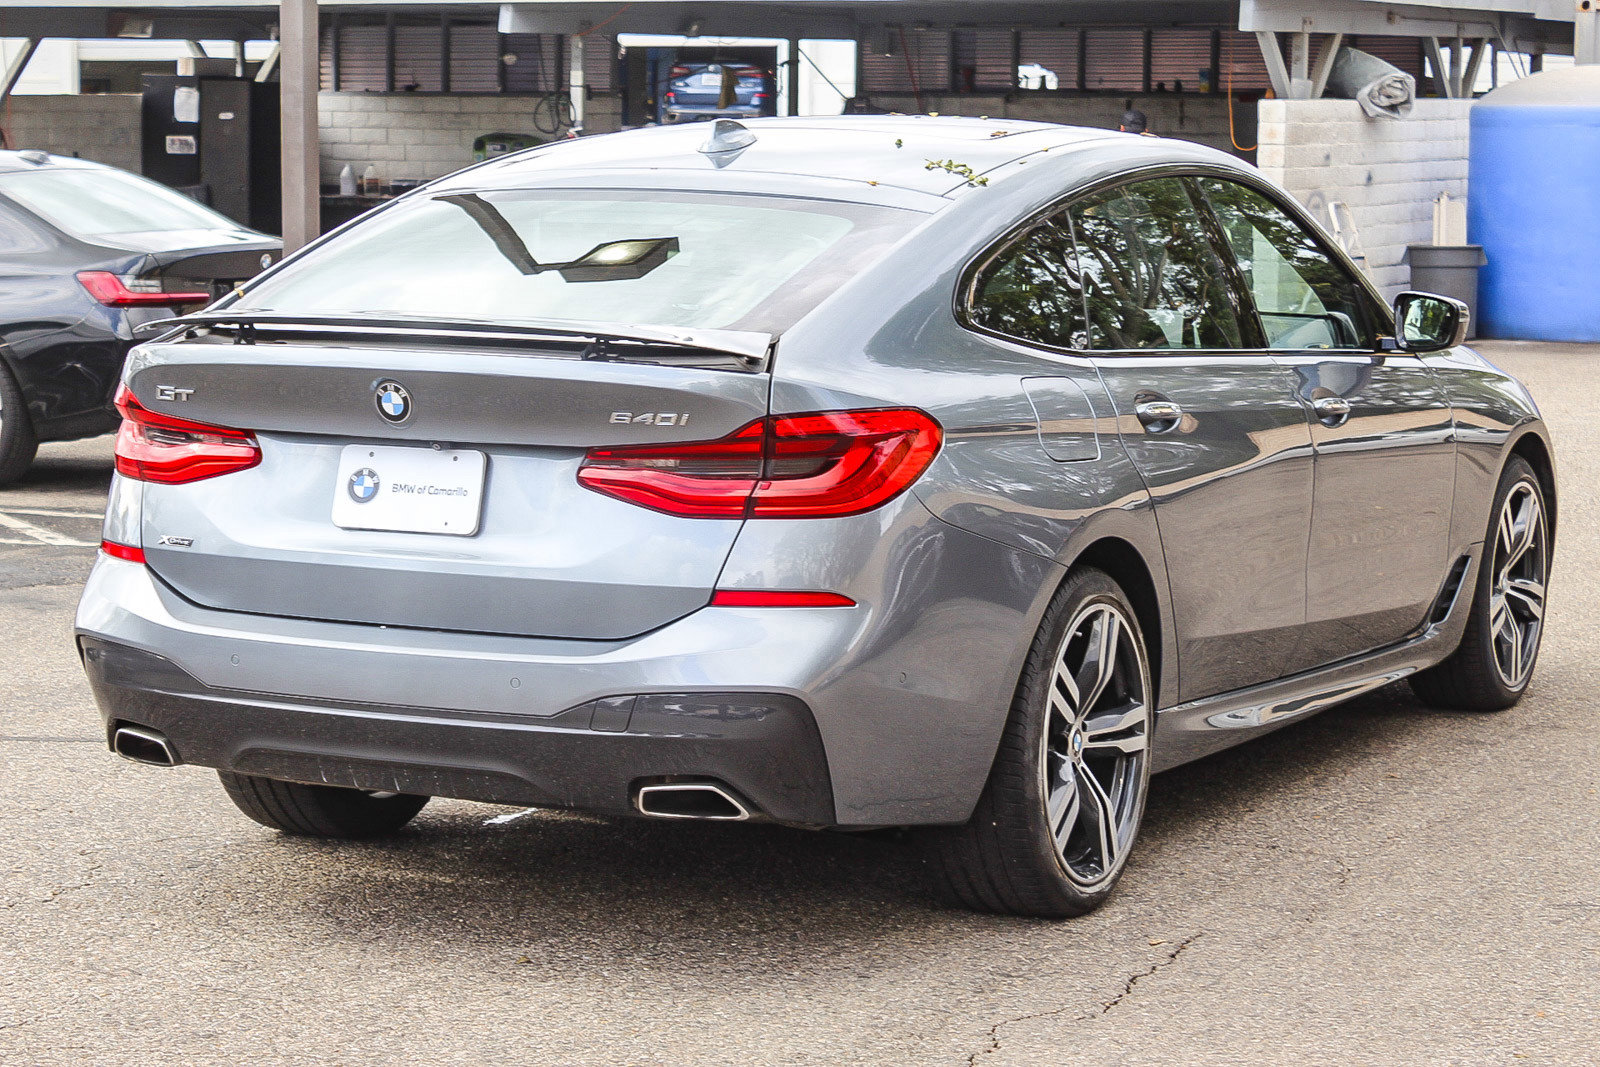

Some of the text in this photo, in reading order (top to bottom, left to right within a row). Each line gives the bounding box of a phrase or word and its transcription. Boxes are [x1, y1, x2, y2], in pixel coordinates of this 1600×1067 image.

[156, 384, 196, 402] GT
[608, 411, 690, 427] 640i
[392, 483, 469, 497] BMW of Camarillo
